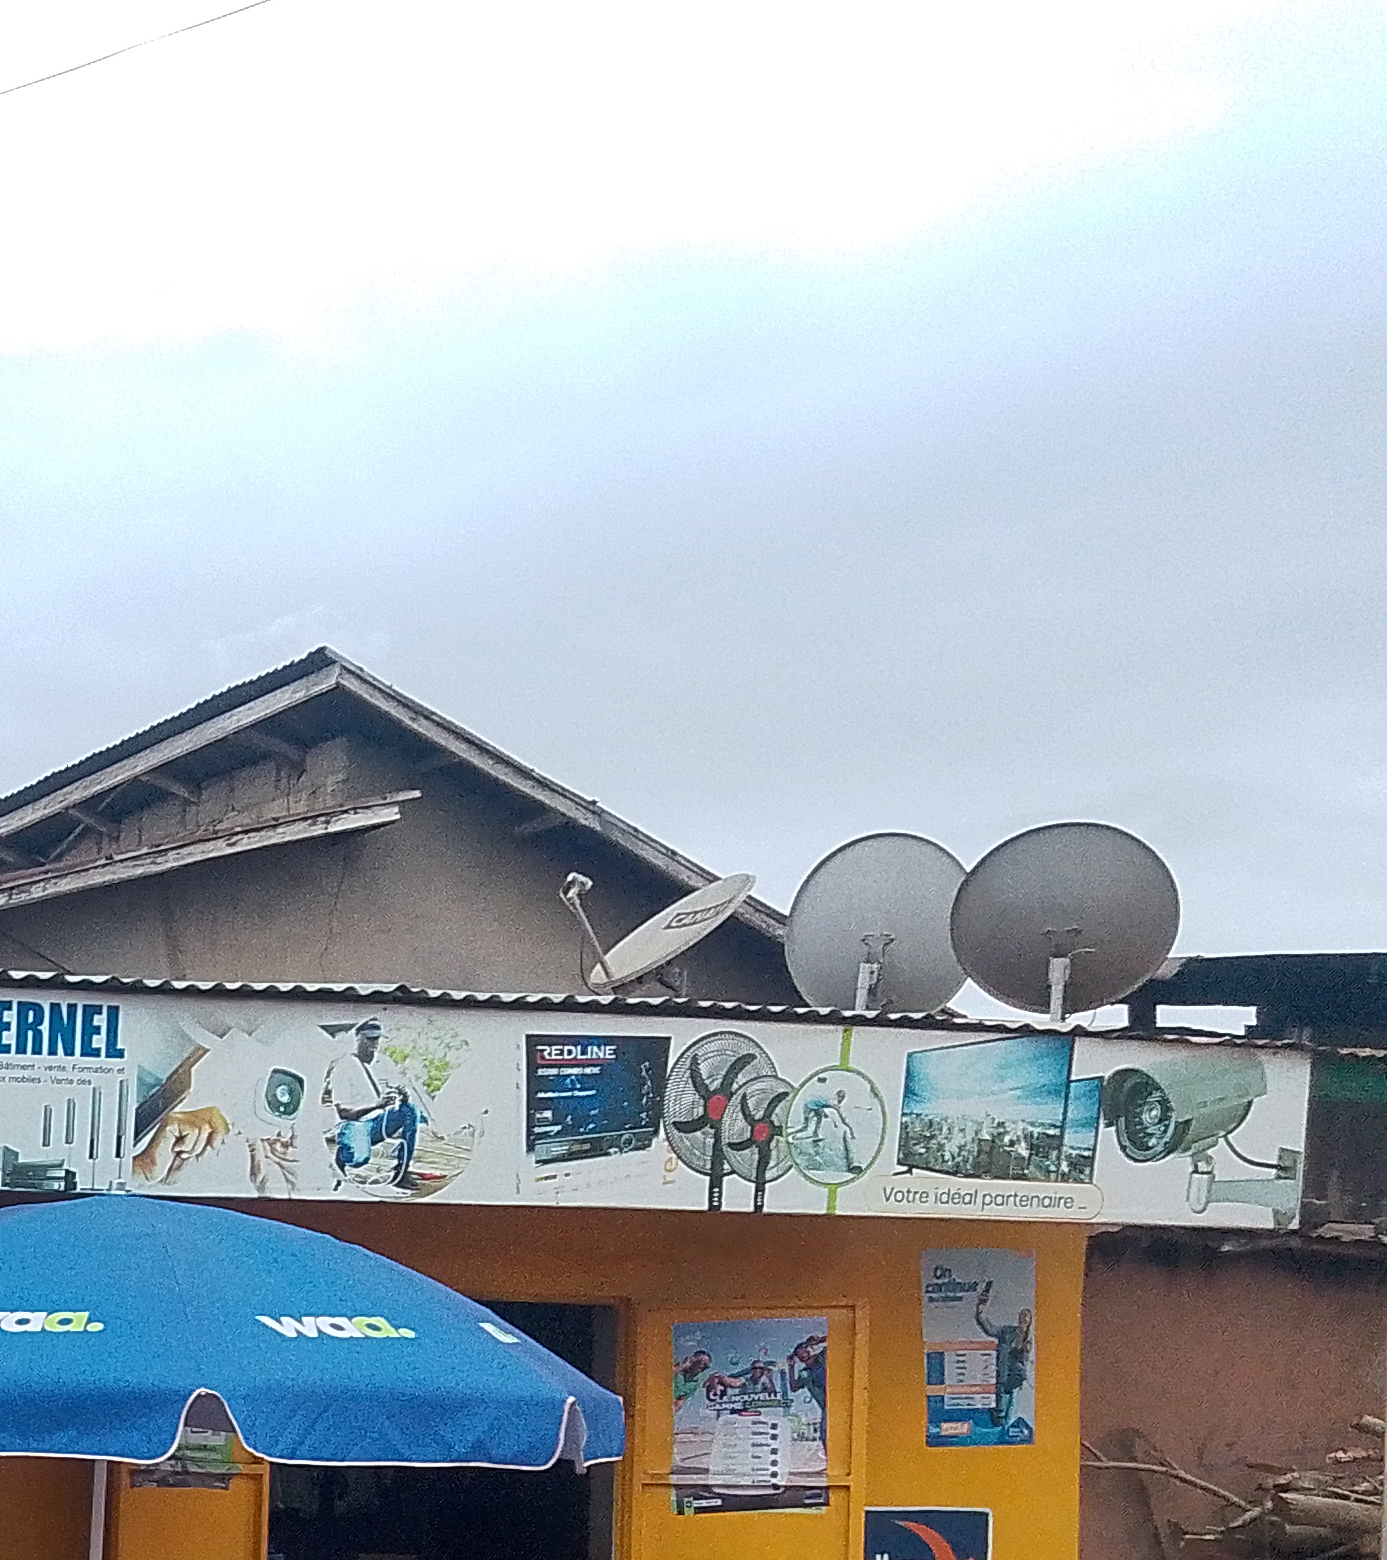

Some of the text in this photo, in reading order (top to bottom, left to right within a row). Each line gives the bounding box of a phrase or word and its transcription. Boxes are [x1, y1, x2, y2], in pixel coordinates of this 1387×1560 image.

[535, 1045, 618, 1060] REDLINE
[116, 1066, 126, 1075] et
[49, 1075, 75, 1086] Vente
[76, 1076, 93, 1086] des
[883, 1185, 1075, 1213] Votre idéal partenaire
